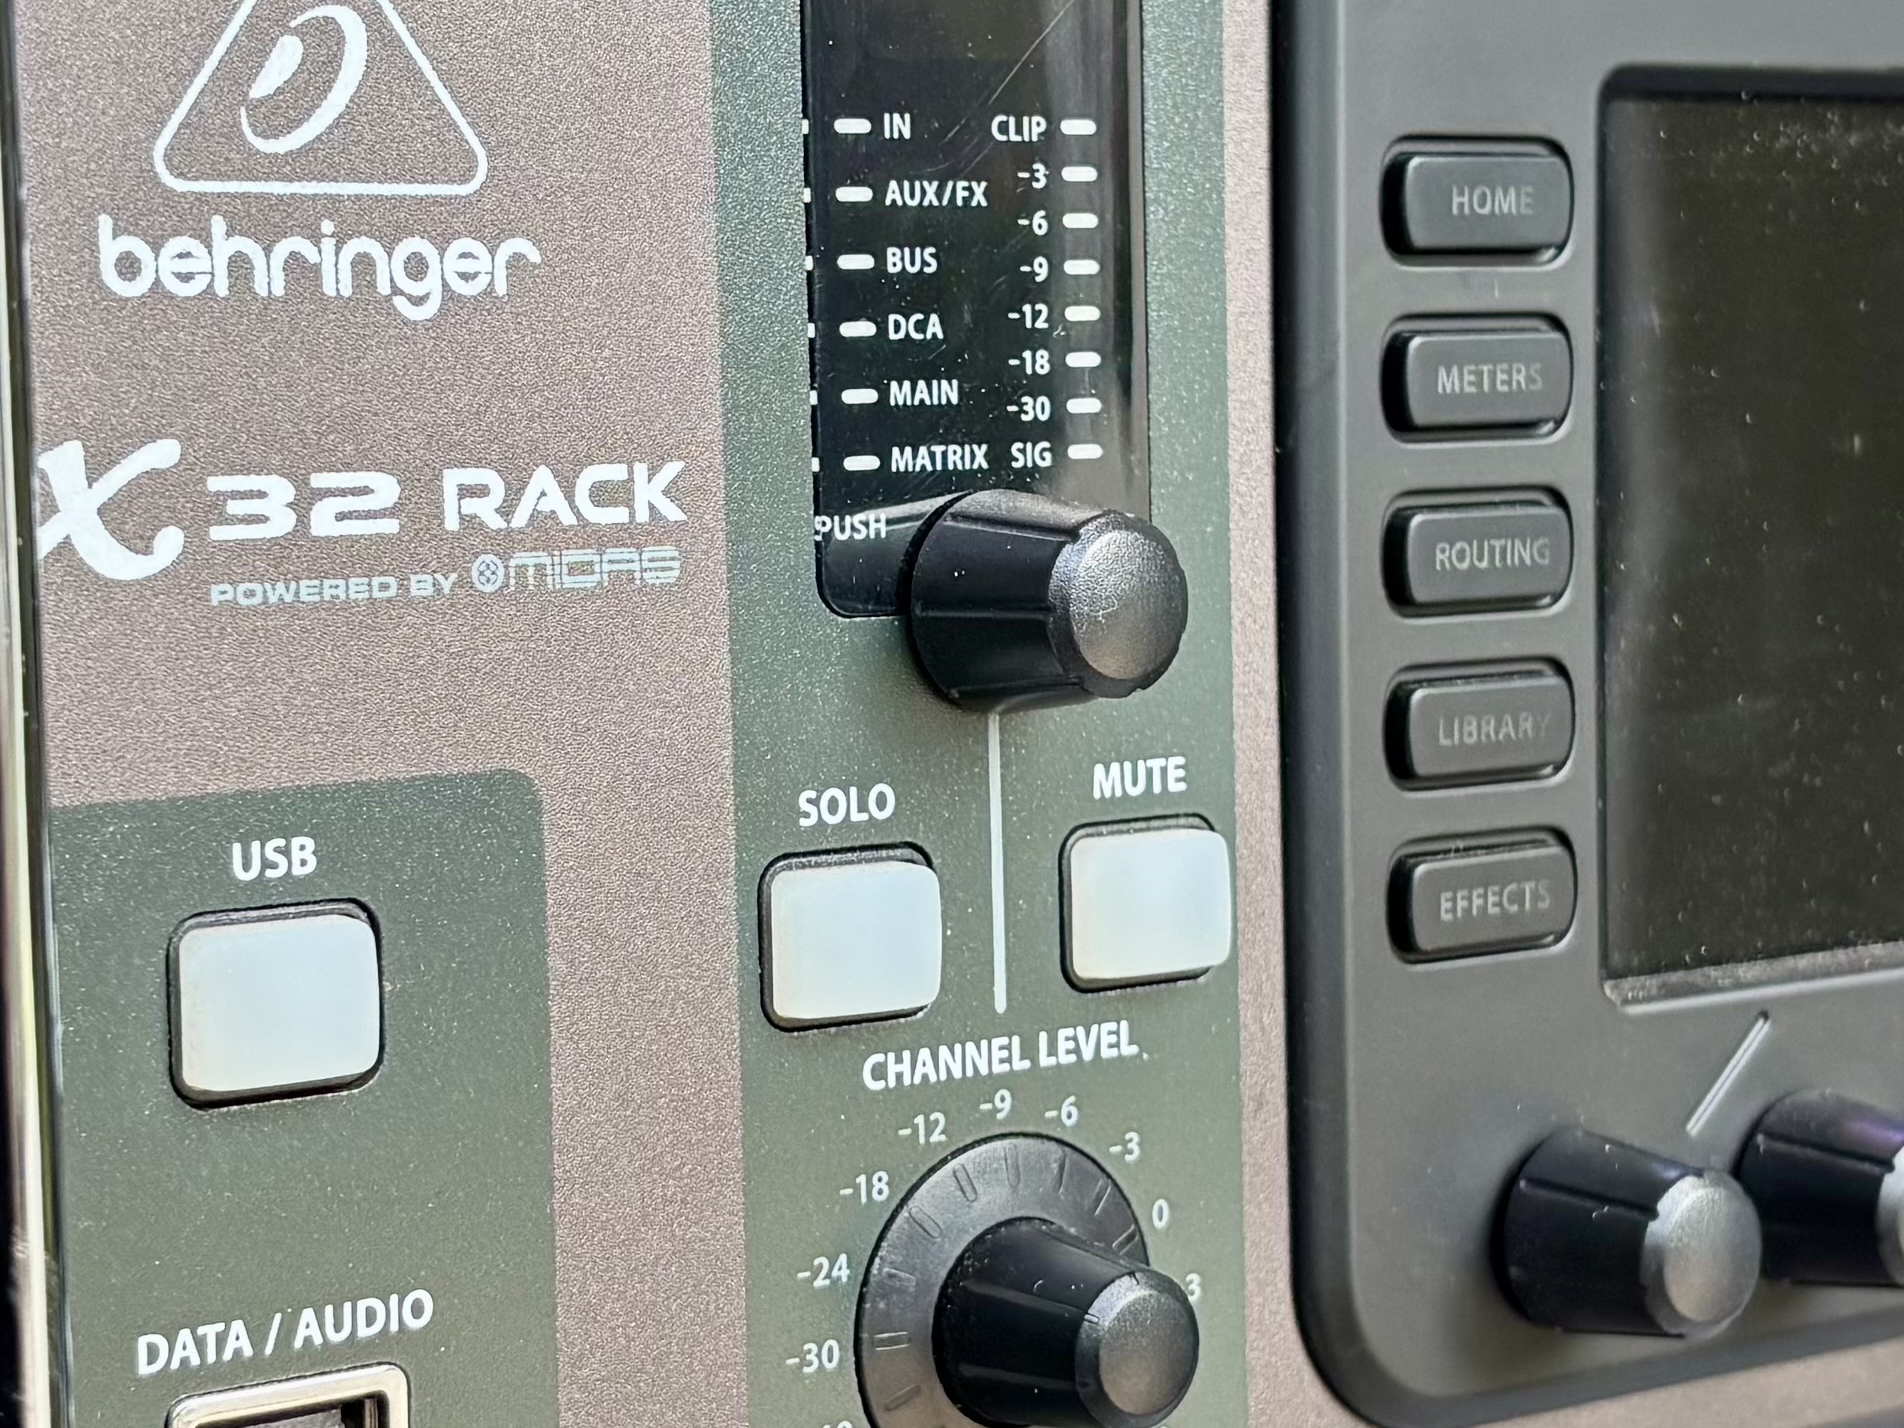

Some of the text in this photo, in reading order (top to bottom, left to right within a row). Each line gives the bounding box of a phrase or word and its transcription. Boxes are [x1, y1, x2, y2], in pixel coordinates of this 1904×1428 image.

[883, 113, 911, 139] IN
[991, 115, 1047, 142] CLIP
[1017, 162, 1048, 189] -3
[885, 180, 987, 207] AUX/FX
[1450, 185, 1534, 217] HOME
[1018, 210, 1048, 236] -6
[97, 213, 542, 321] behringer
[886, 246, 938, 274] BUS
[1020, 256, 1049, 282] -9
[888, 313, 944, 340] DCA
[1008, 303, 1049, 329] -12
[1008, 349, 1051, 375] -18
[889, 379, 959, 406] MAIN
[1437, 363, 1542, 394] METERS
[1007, 395, 1051, 422] -30
[891, 444, 988, 472] MATRIX
[1011, 441, 1052, 468] SIG
[442, 460, 688, 532] RACK
[815, 513, 886, 542] PUSH
[1436, 538, 1550, 570] ROUTING
[210, 576, 398, 606] POWERED
[409, 572, 458, 597] BY
[1439, 710, 1551, 745] LIBRARY
[1093, 756, 1187, 799] MUTE
[798, 783, 896, 827] SOLO
[232, 836, 317, 881] USB
[1439, 880, 1551, 922] EFFECTS
[862, 1020, 1139, 1091] CHANNEL LEVEL
[979, 1089, 1012, 1120] -9
[1045, 1095, 1078, 1127] -6
[898, 1112, 947, 1145] -12
[1109, 1131, 1140, 1162] -3
[839, 1171, 889, 1204] -18
[1152, 1199, 1169, 1229] 0
[797, 1253, 850, 1288] -24
[137, 1289, 434, 1376] DATA / AUDIO
[786, 1339, 840, 1374] -30
